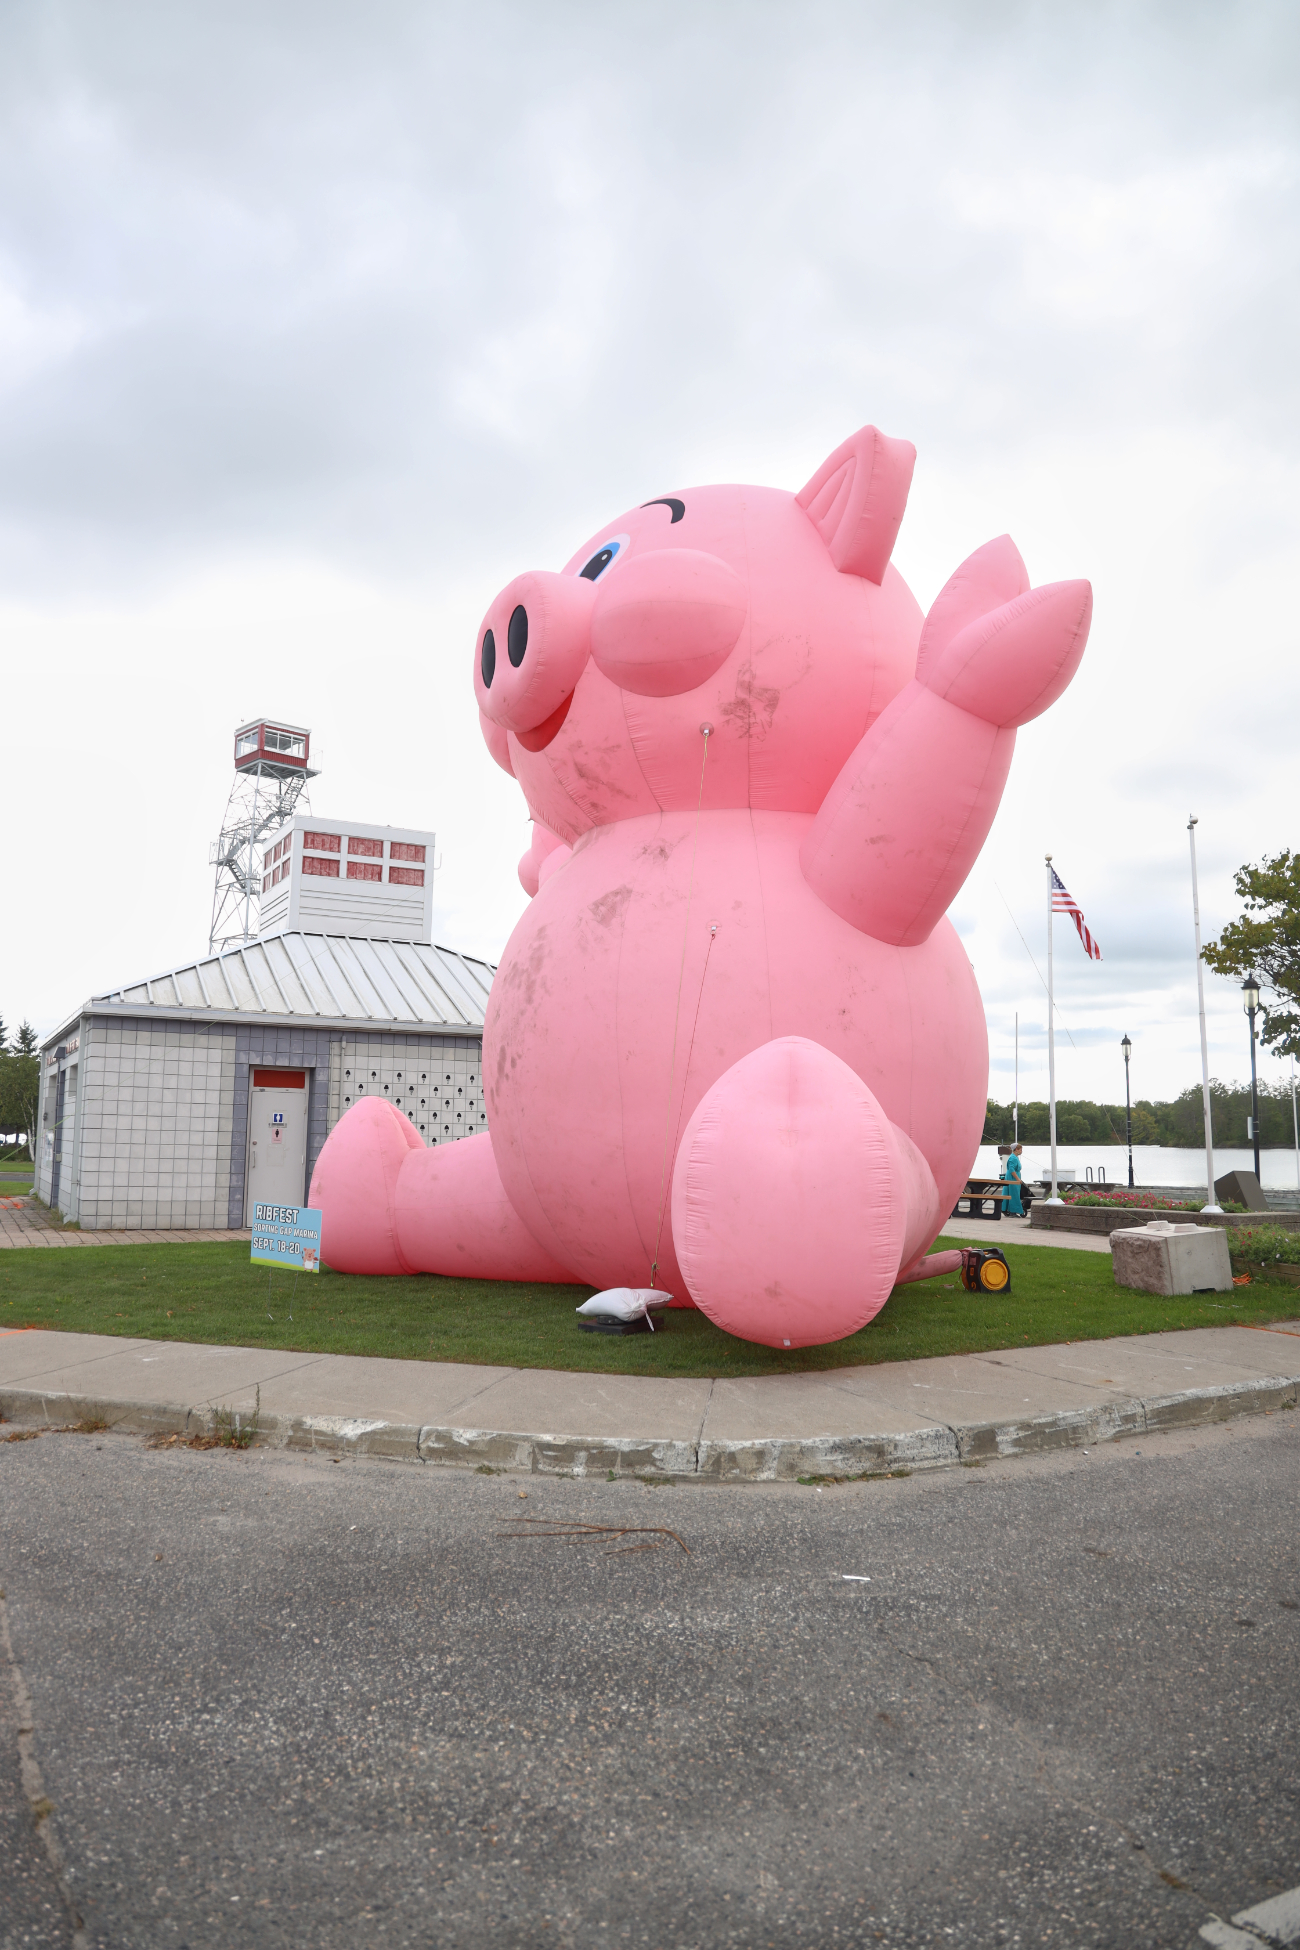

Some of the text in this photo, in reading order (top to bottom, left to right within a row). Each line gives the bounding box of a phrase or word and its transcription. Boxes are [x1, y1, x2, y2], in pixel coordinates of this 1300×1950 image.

[256, 1204, 299, 1224] RIBFEST
[253, 1223, 318, 1240] SORTING GAP MARINA
[253, 1237, 300, 1254] SEPT. 18-20
